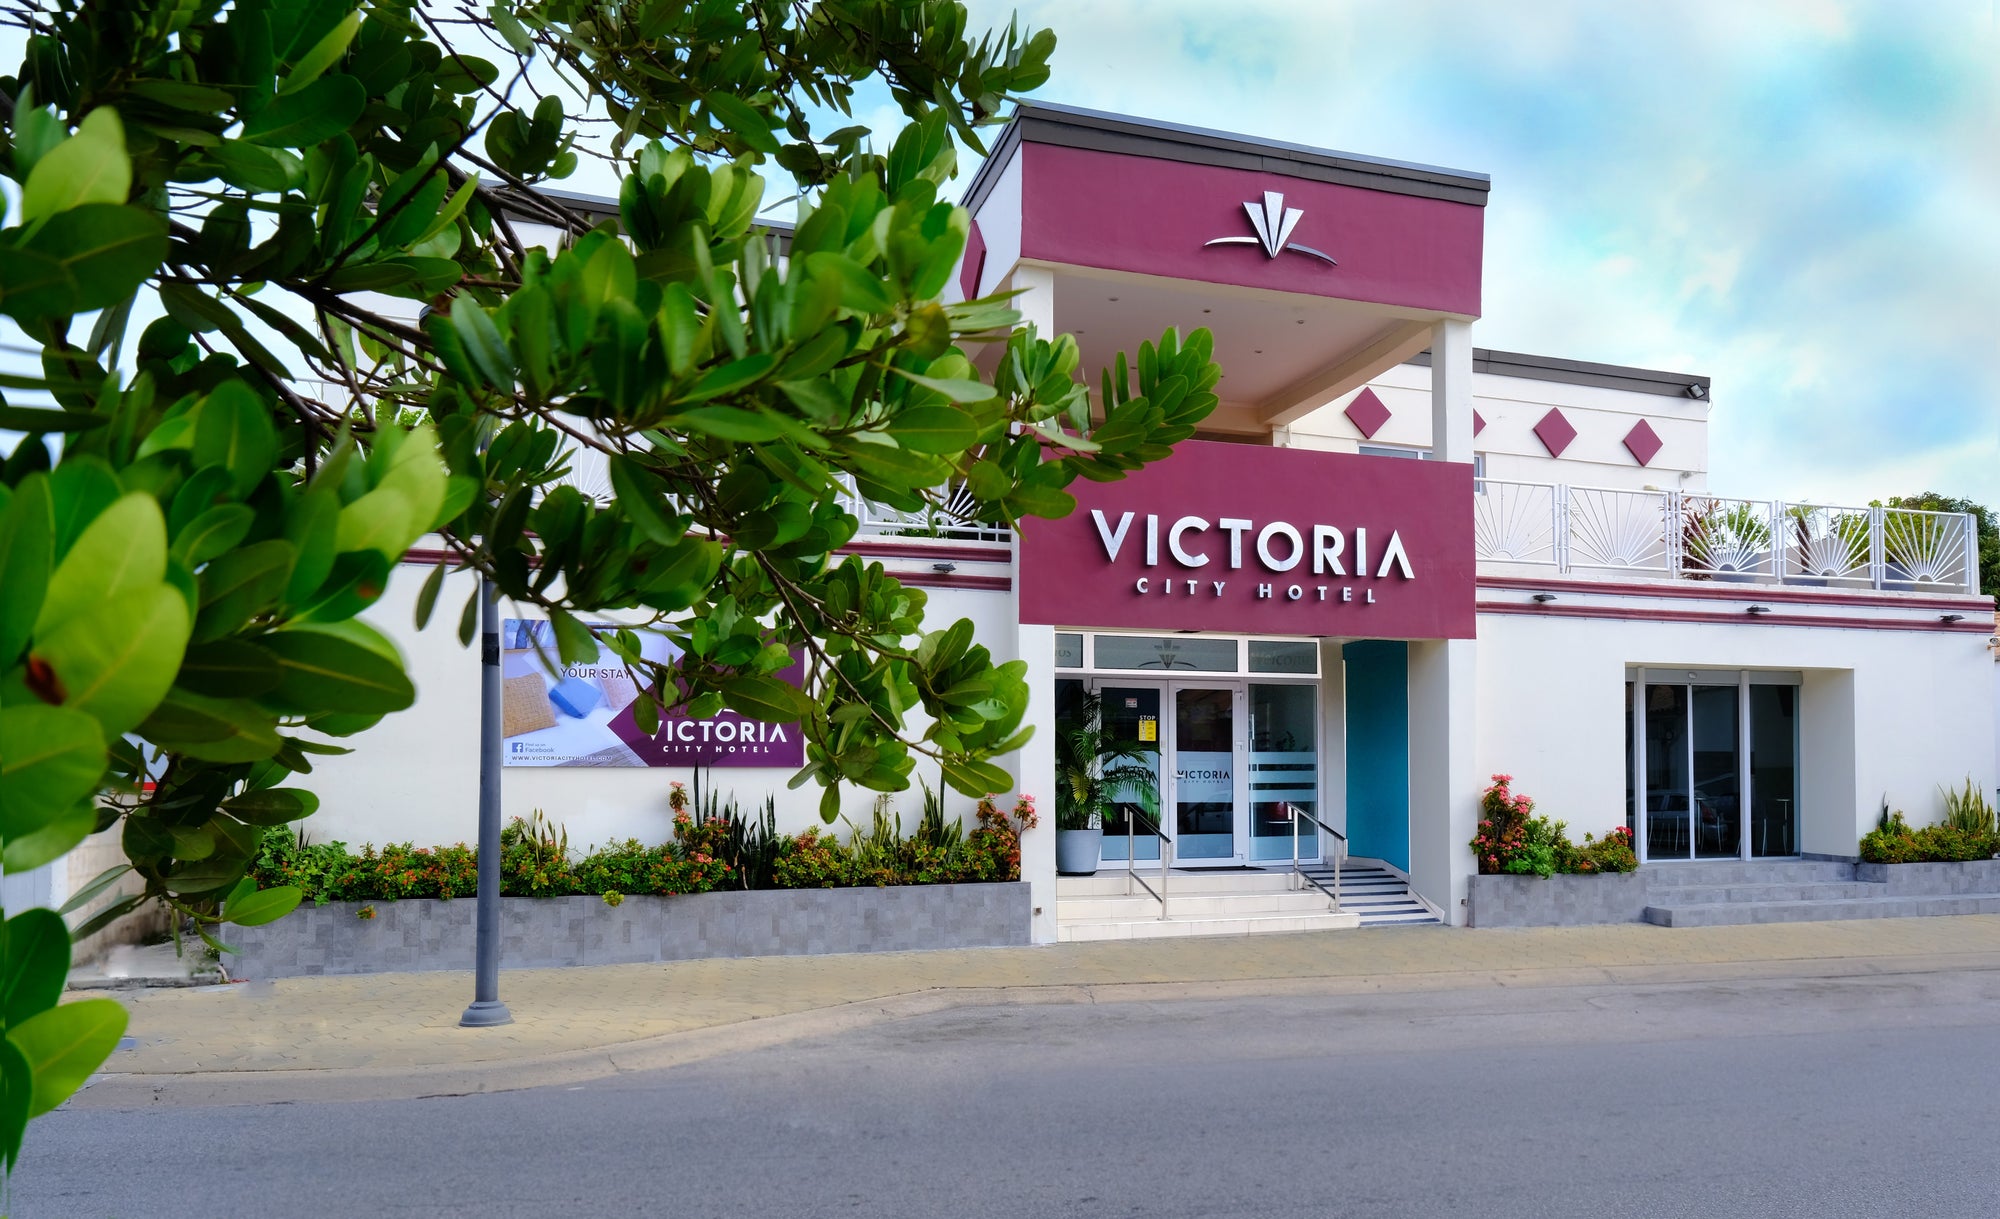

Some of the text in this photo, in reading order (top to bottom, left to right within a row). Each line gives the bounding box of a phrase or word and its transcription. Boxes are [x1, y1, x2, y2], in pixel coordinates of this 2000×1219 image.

[1090, 509, 1416, 580] VICTORIA
[1136, 577, 1376, 604] CITY HOTEL
[560, 667, 630, 679] YOUR STAY
[663, 745, 769, 753] CITY HOTEL
[1177, 770, 1230, 779] VICTORIA
